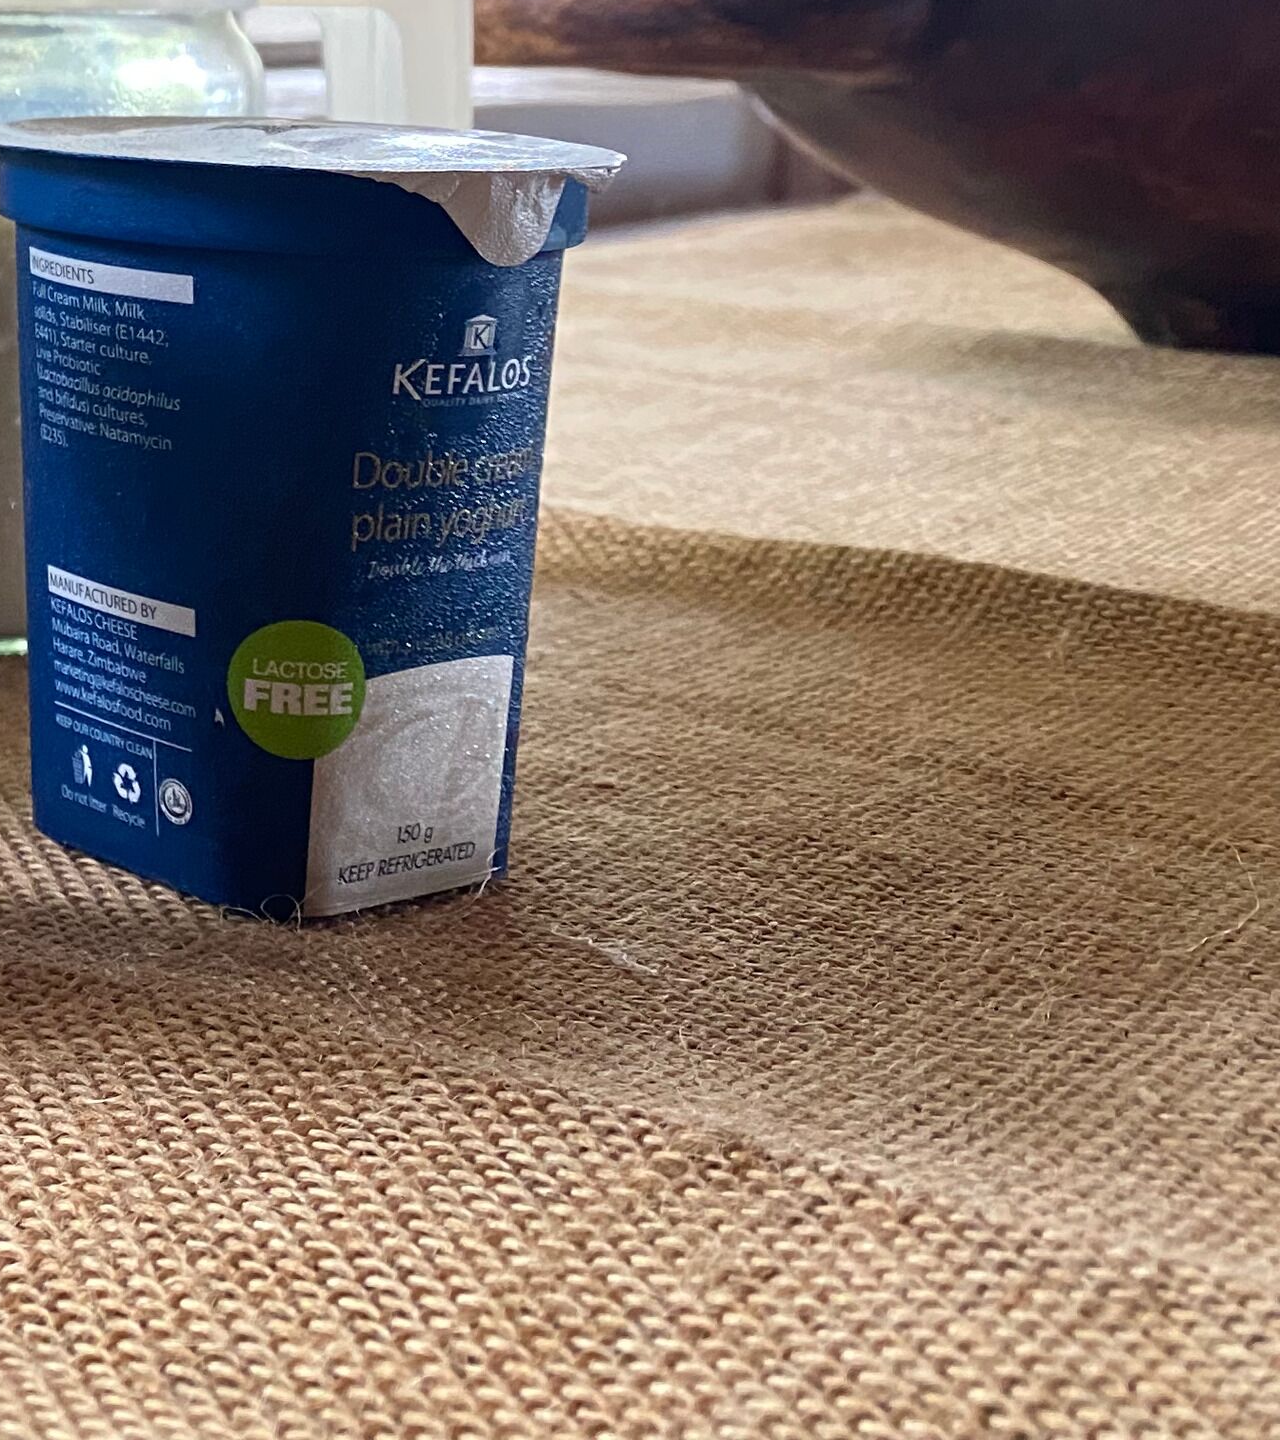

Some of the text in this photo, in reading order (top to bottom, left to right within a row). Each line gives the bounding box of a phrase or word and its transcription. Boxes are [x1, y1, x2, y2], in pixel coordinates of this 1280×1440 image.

[47, 286, 79, 308] Cream
[115, 301, 145, 321] Milk
[59, 311, 111, 337] Stabiliser
[473, 326, 488, 349] K
[60, 334, 96, 355] Starter
[53, 349, 101, 376] Probiotic
[392, 354, 534, 401] KEFALOS
[102, 383, 180, 411] acidophilus
[92, 403, 148, 428] cultures,
[99, 422, 173, 451] Natamycin
[352, 451, 469, 489] Double
[351, 503, 431, 553] plain
[49, 572, 157, 620] MANUFACTURED BY
[50, 596, 139, 641] KEFALOS CHEESE
[87, 650, 147, 683] Zimbabwe
[124, 644, 185, 674] Waterfalls
[253, 658, 348, 679] LACTOSE
[55, 679, 172, 732] www.kefalosfood.com
[244, 678, 353, 716] FREE
[126, 741, 153, 760] CLEAN
[397, 823, 433, 844] 150 g
[338, 841, 475, 885] KEEP REFRIGERATED
